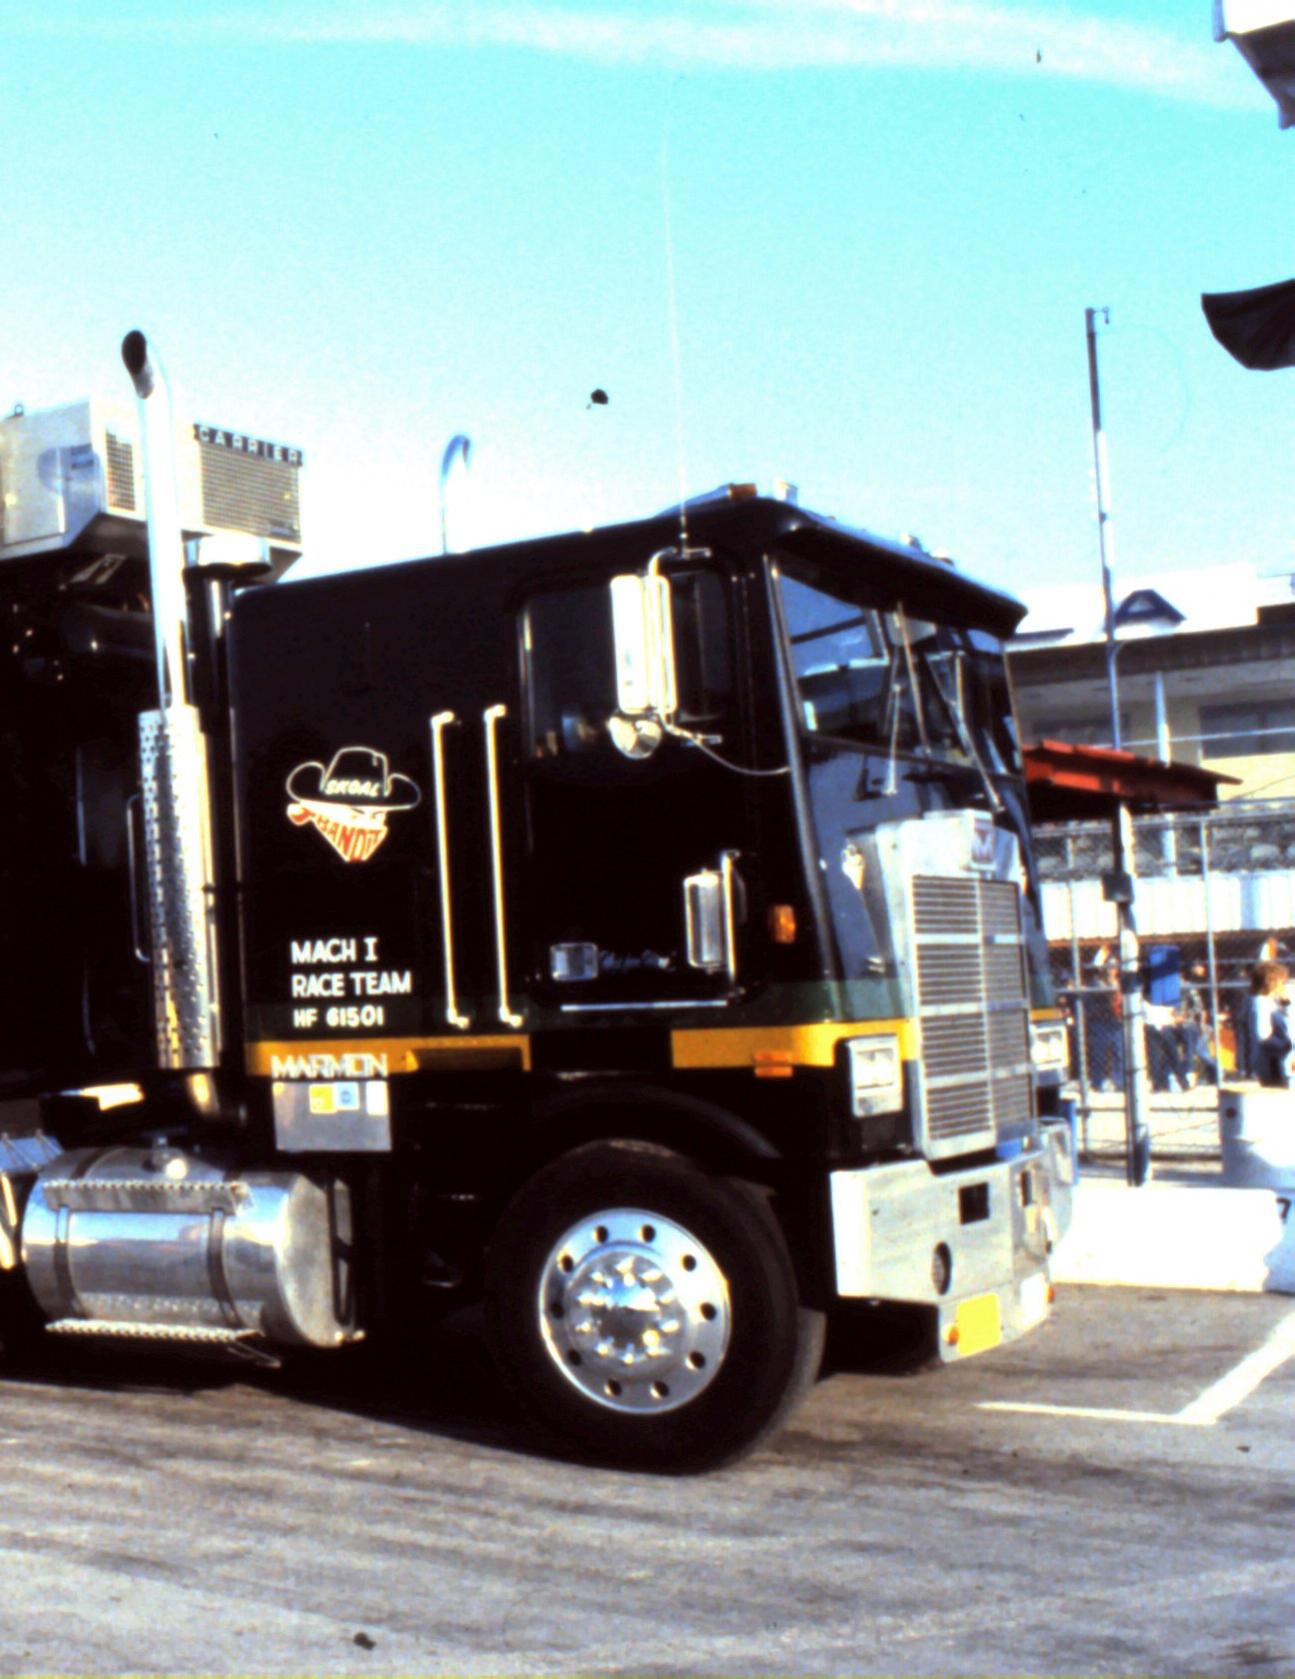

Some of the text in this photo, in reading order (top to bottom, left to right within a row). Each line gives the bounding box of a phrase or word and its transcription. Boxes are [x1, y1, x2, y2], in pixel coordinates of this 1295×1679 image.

[199, 425, 298, 464] CARRIER
[324, 780, 380, 797] SKOAL
[291, 936, 378, 964] MACH I
[291, 970, 411, 998] RACE TEAM
[326, 1004, 384, 1027] 61501
[270, 1053, 388, 1079] MARMON
